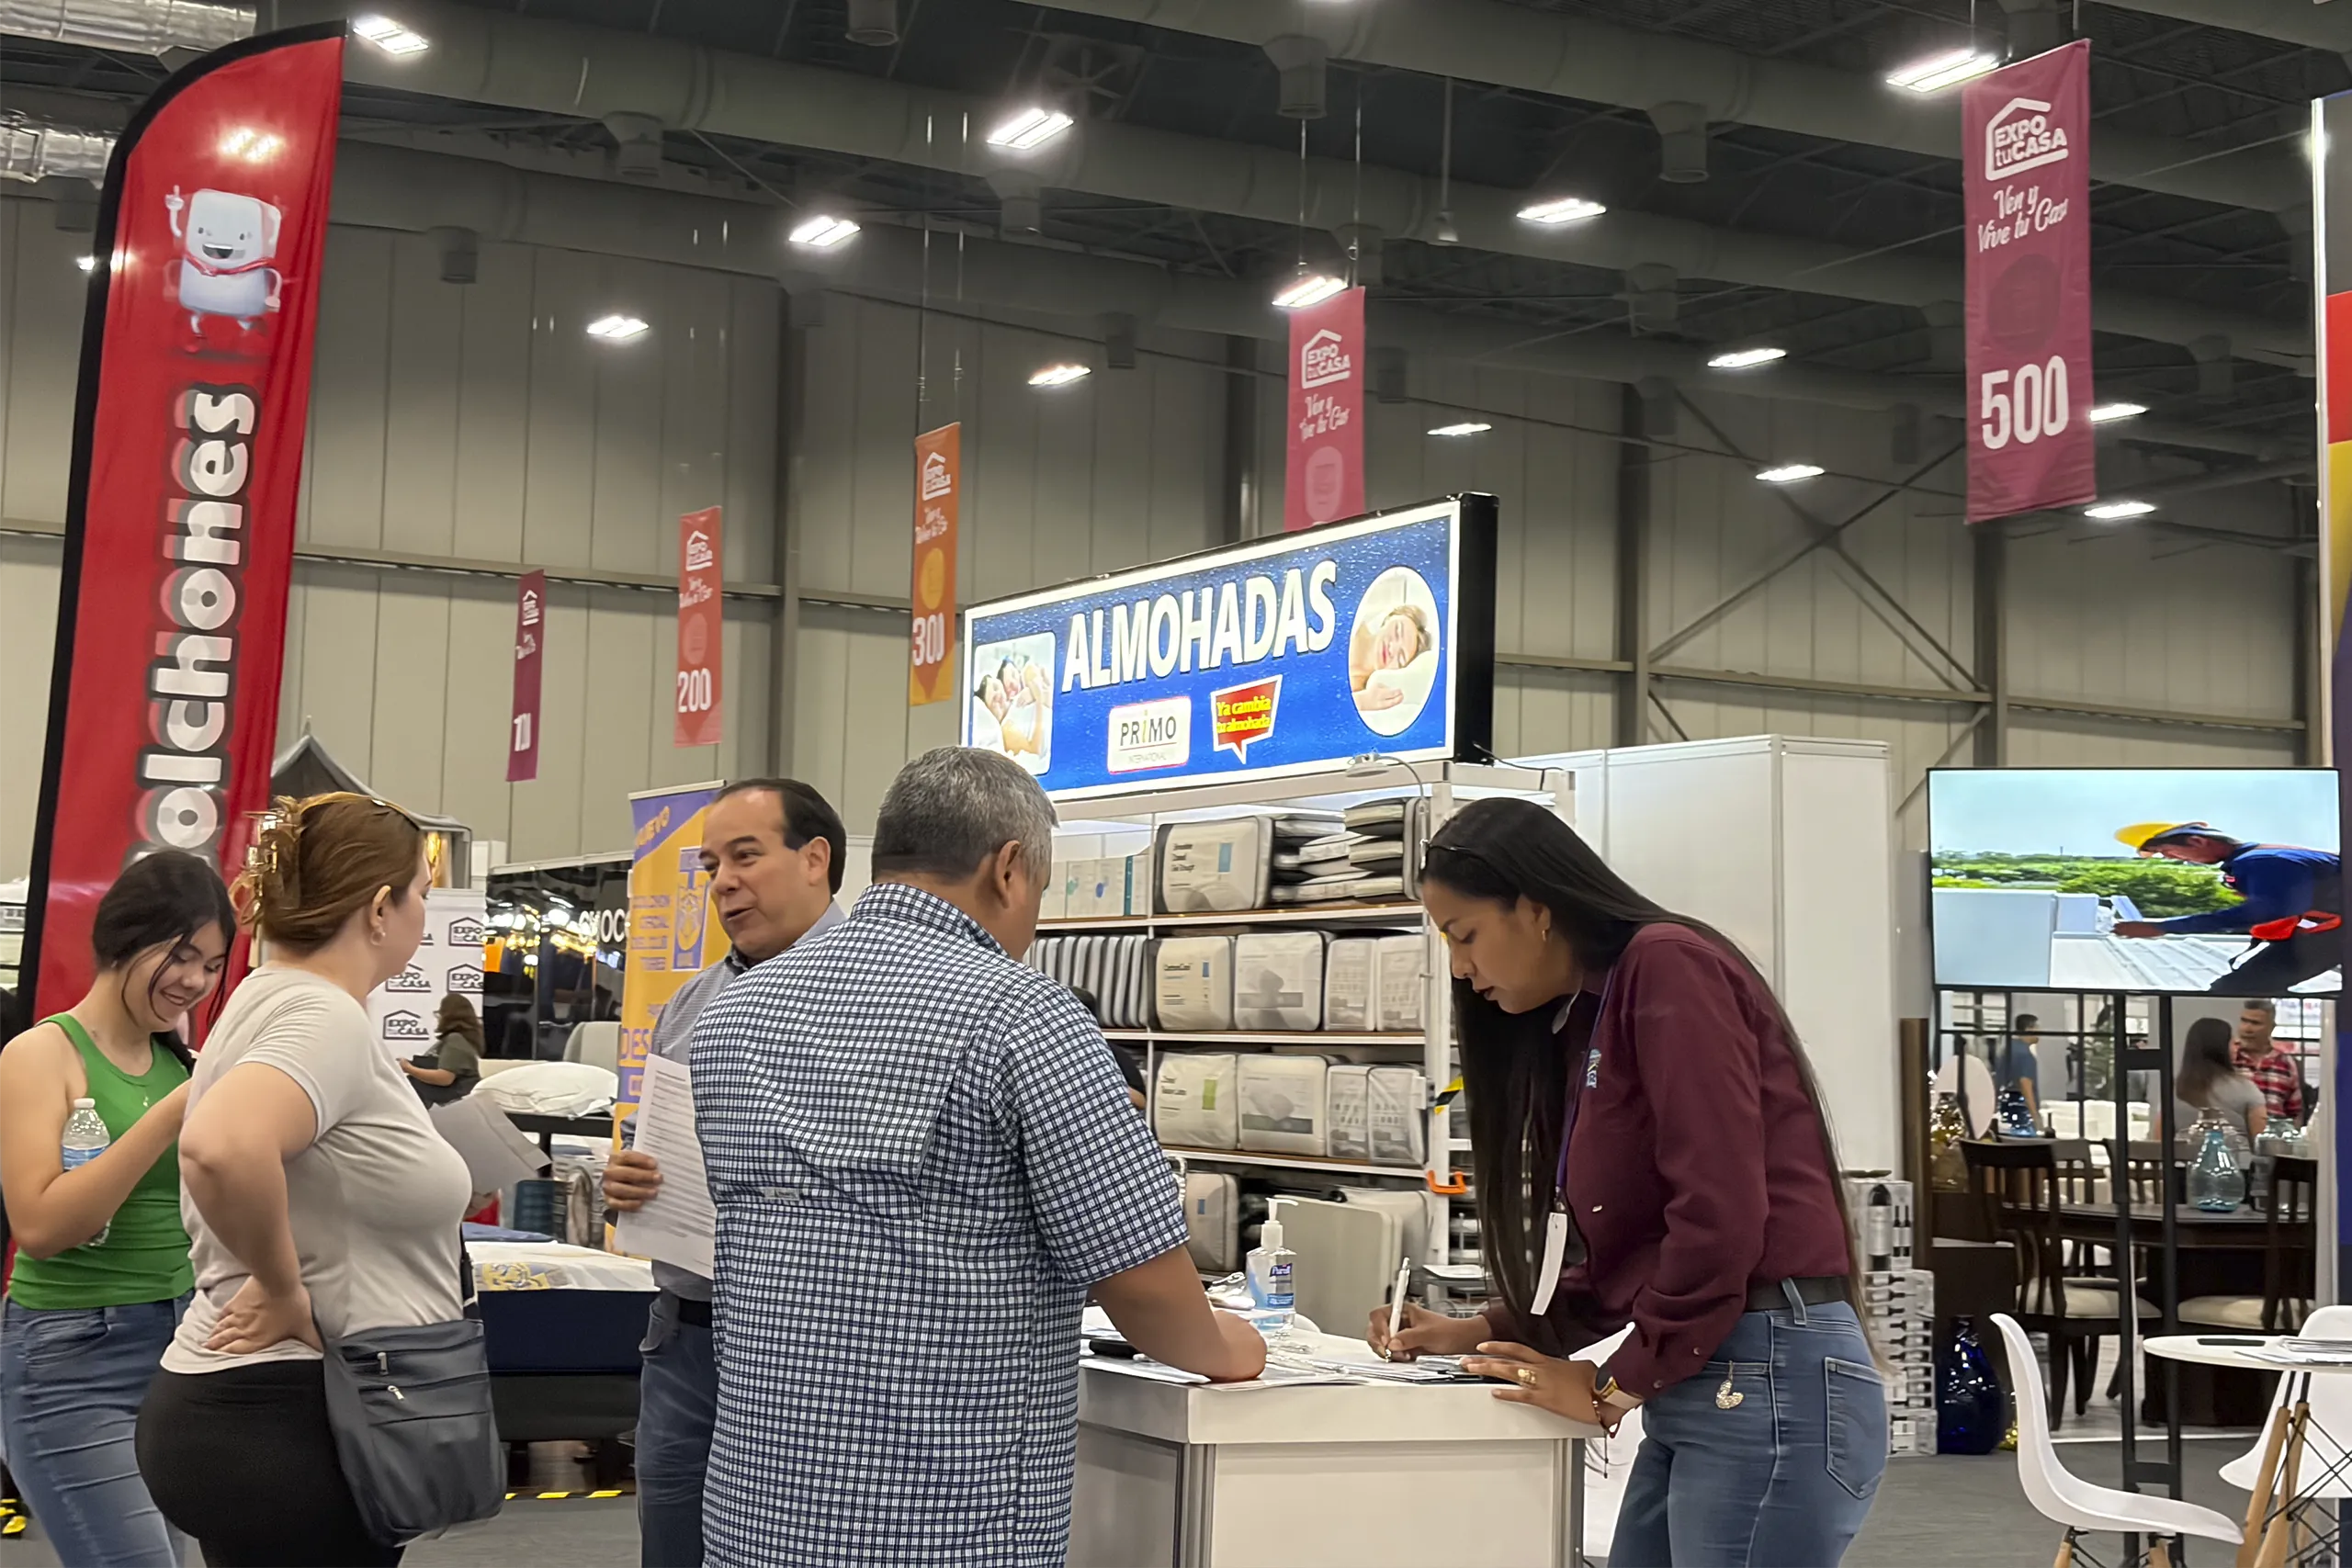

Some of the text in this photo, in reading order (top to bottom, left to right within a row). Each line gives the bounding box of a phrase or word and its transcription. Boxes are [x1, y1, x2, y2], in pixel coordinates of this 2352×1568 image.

[1995, 115, 2046, 148] EXPO
[1996, 128, 2067, 166] tuCASA
[1993, 185, 2040, 220] Ven y
[1978, 220, 2011, 253] Vive
[2014, 211, 2030, 239] tu
[1307, 344, 1339, 365] EXPO
[1981, 355, 2069, 449] 500
[138, 392, 255, 859] olchones
[1061, 558, 1338, 694] ALMOHADAS
[678, 668, 712, 713] 200
[1216, 694, 1272, 716] Ya cambia
